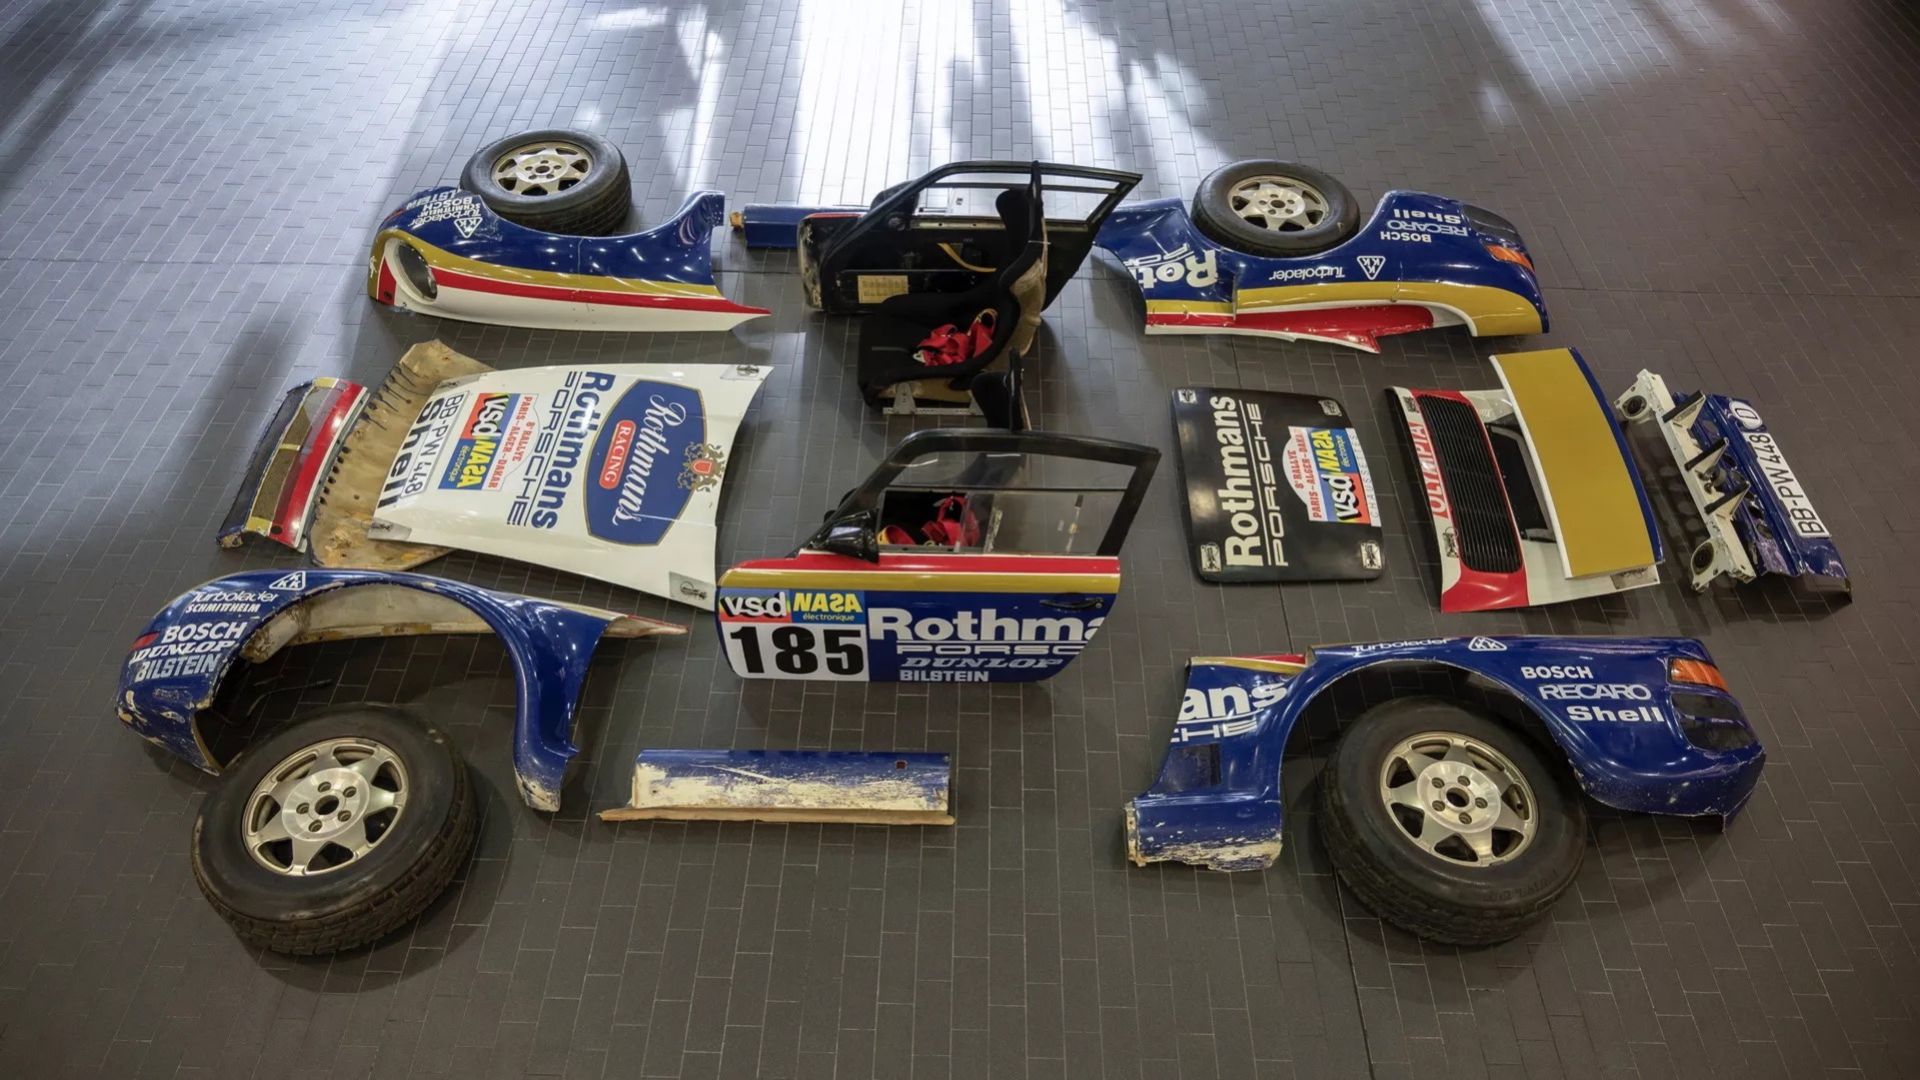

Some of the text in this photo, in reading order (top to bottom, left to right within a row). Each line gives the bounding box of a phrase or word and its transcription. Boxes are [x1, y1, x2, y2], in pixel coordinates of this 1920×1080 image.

[423, 196, 472, 211] BOSCH
[1393, 208, 1461, 224] Shell
[1380, 231, 1432, 243] BOSCH
[1387, 219, 1469, 237] RECARO
[1269, 265, 1346, 281] Turbolader
[472, 396, 509, 437] vsd
[1735, 408, 1758, 421] D
[378, 398, 445, 508] Shell
[404, 394, 464, 494] BB-PW 448
[512, 430, 532, 462] RALLYE
[530, 370, 616, 529] Rothmans
[604, 425, 633, 482] RACING
[613, 393, 687, 526] Rothmans
[1287, 449, 1302, 480] RALLYE
[1410, 425, 1446, 513] OLYMPIA
[1210, 396, 1264, 568] Rothmans
[1246, 403, 1289, 567] PORSCHE
[1749, 434, 1823, 533] BB-PW 448
[1320, 474, 1360, 518] vsd
[723, 590, 787, 617] vsd
[793, 592, 863, 613] NASA
[803, 613, 855, 622] électronique
[161, 622, 247, 643] BOSCH
[131, 640, 235, 663] DUNLOP
[730, 625, 865, 675] 185
[900, 657, 1064, 669] DUNLOP
[134, 653, 222, 683] BILSTEIN
[900, 670, 989, 682] BILSTEIN
[1520, 666, 1594, 679] BOSCH
[1538, 684, 1652, 700] RECARO
[1566, 705, 1665, 722] Shell
